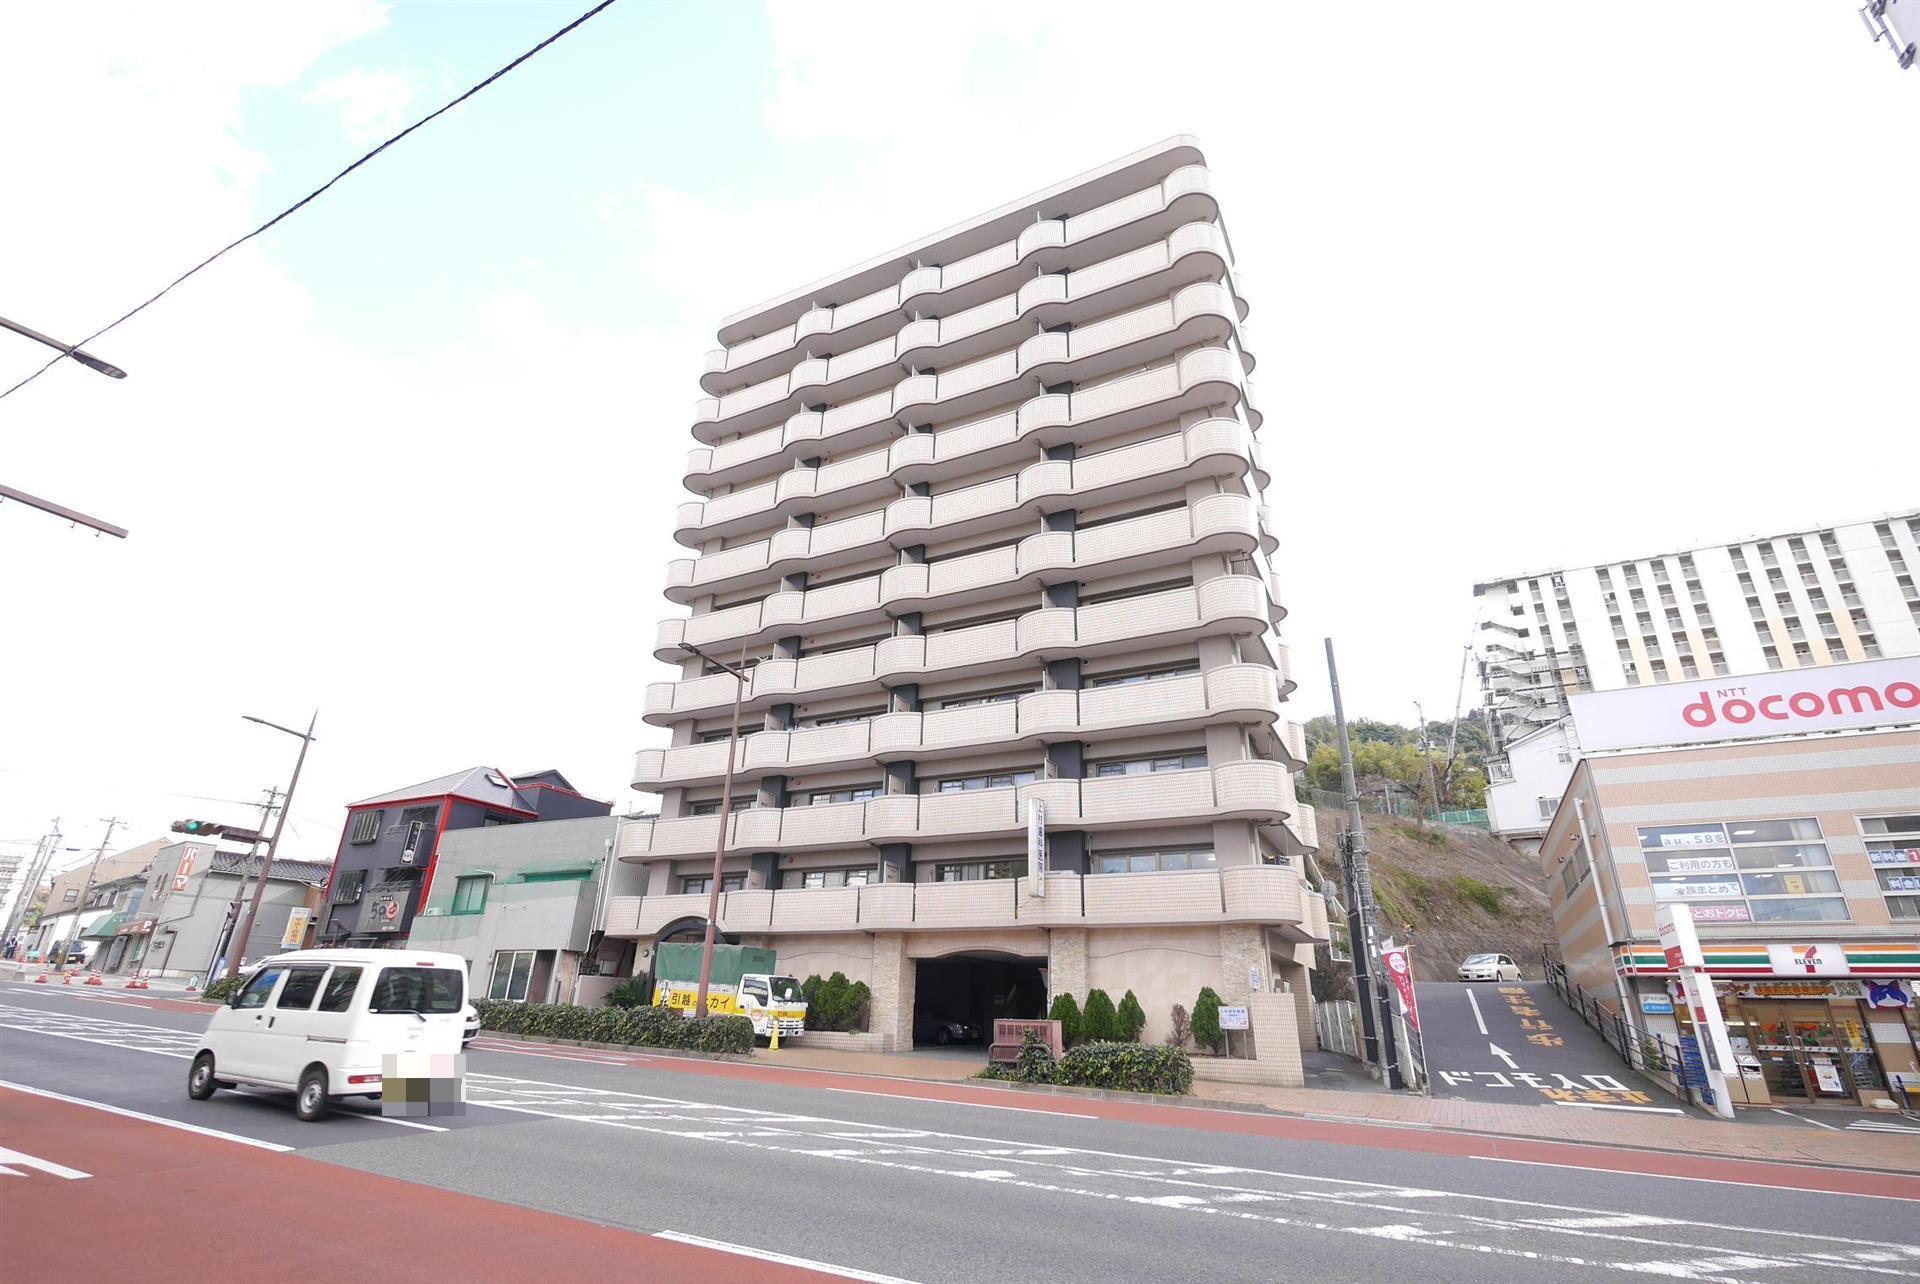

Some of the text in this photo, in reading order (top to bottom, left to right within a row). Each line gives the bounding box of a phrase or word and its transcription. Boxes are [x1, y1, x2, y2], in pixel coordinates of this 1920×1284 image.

[1717, 687, 1747, 698] NTT
[1682, 681, 1920, 727] docomo
[174, 847, 199, 889] パーマ
[1669, 859, 1733, 871] ご利用の方も
[1675, 882, 1738, 896] 家族まとめて
[1690, 907, 1748, 919] とおトクに
[1438, 1070, 1630, 1092] ドコモ入口
